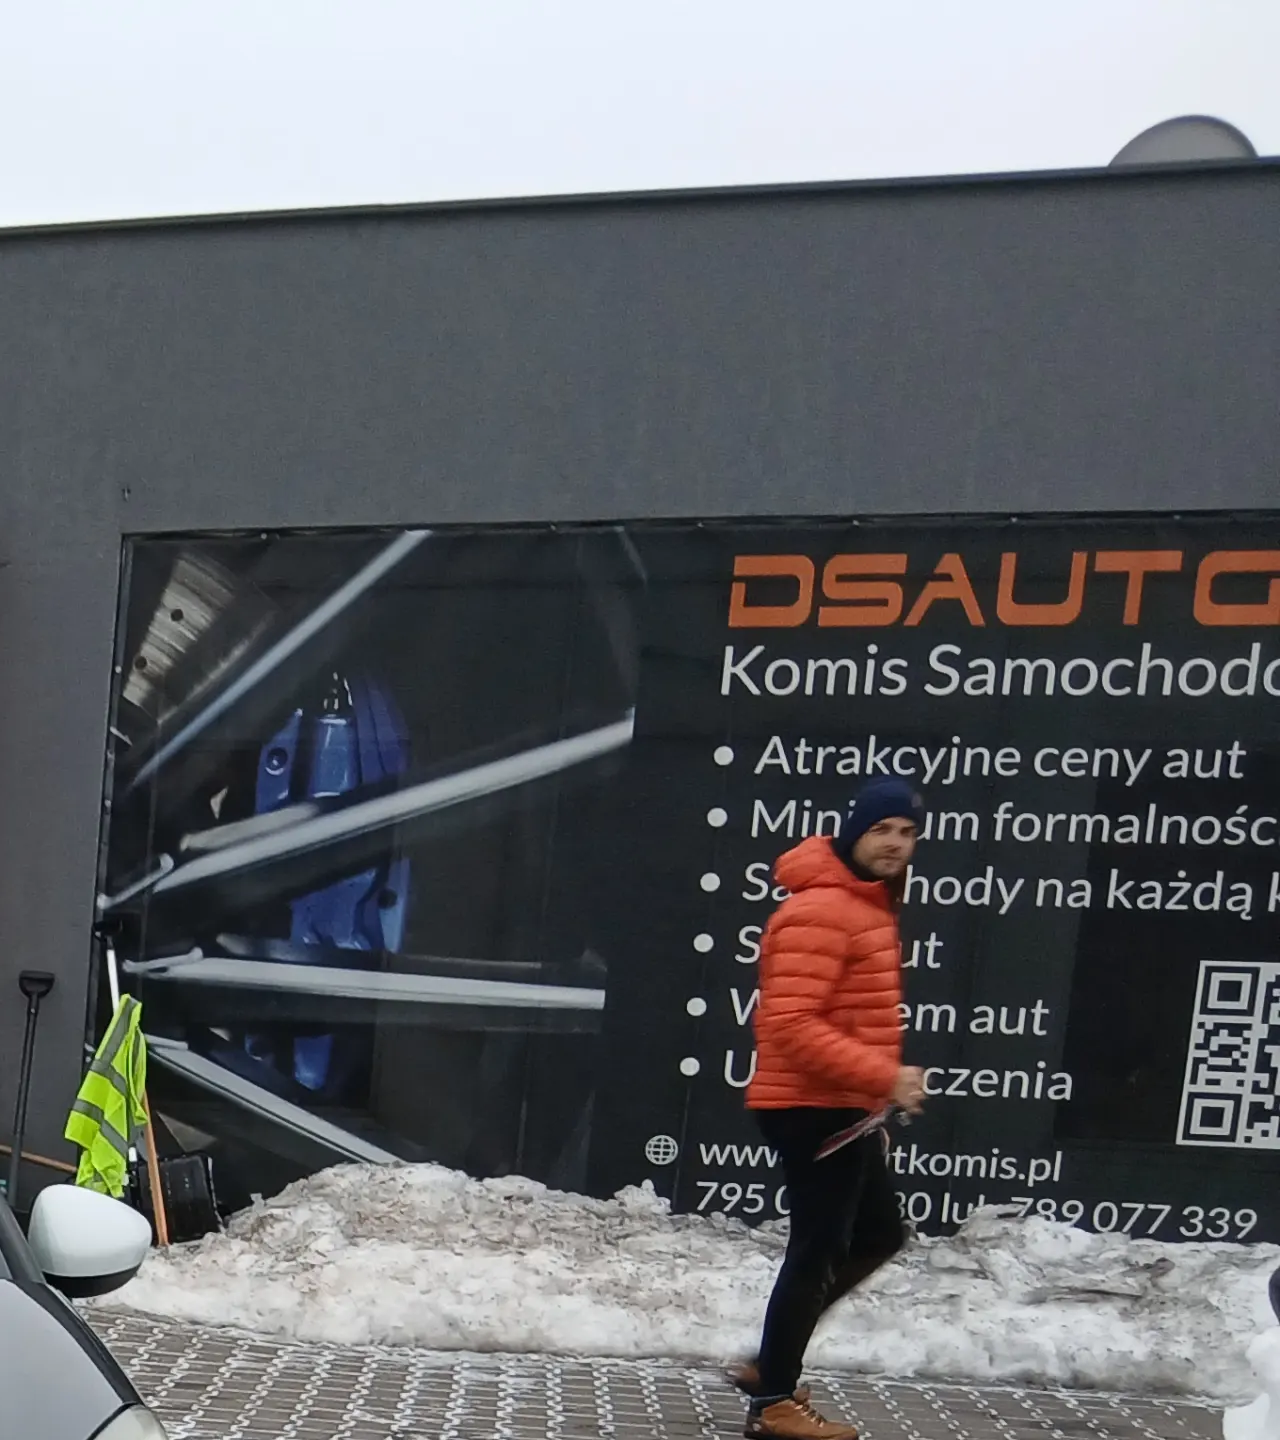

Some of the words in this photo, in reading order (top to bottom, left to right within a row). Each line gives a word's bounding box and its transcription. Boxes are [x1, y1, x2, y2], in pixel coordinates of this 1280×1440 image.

[720, 643, 908, 697] Komis
[754, 735, 1022, 785] Atrakcyjne
[1033, 745, 1152, 787] ceny
[1162, 739, 1247, 780] aut
[993, 801, 1280, 847] formalnośc
[1036, 873, 1094, 909] na
[1107, 869, 1253, 921] każdą
[970, 999, 1050, 1036] aut
[696, 1181, 765, 1214] 795
[1092, 1201, 1172, 1235] 077
[1178, 1206, 1258, 1240] 339
